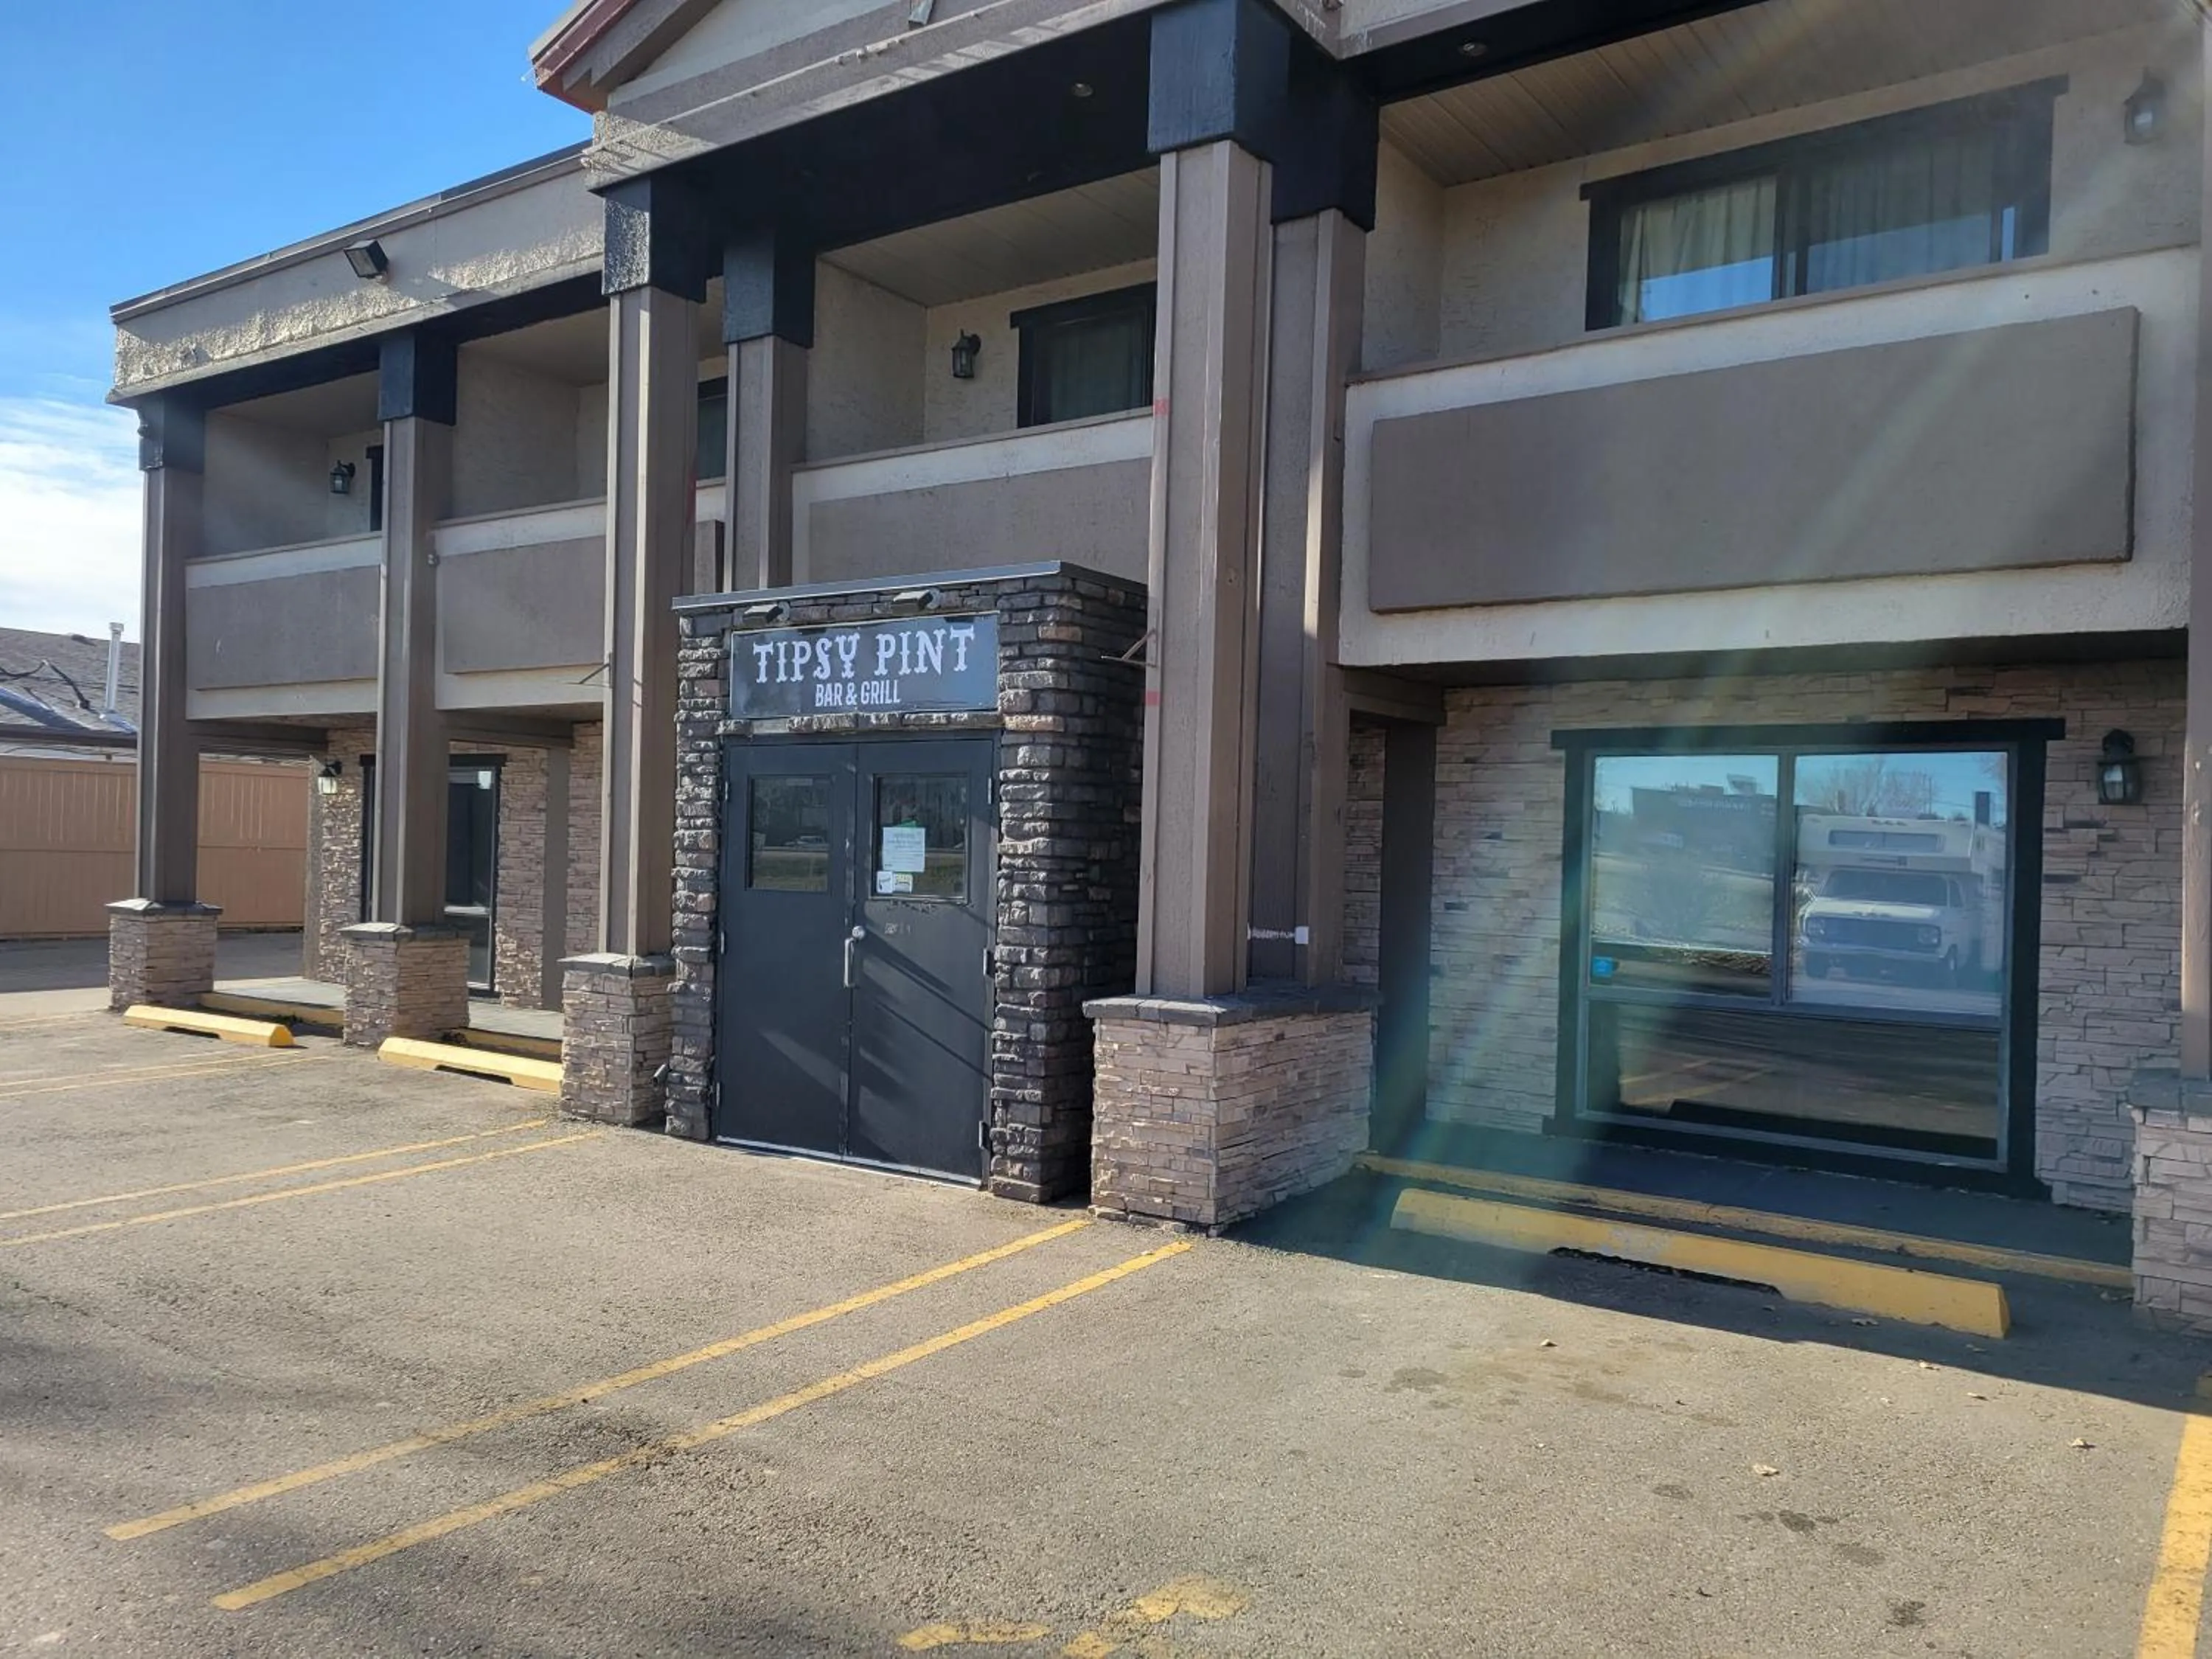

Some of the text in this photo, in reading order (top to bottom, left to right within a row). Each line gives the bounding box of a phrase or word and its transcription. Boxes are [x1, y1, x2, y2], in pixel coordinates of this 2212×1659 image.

[753, 625, 975, 684] TIPSY PINT
[815, 679, 901, 707] BAR & GRILL
